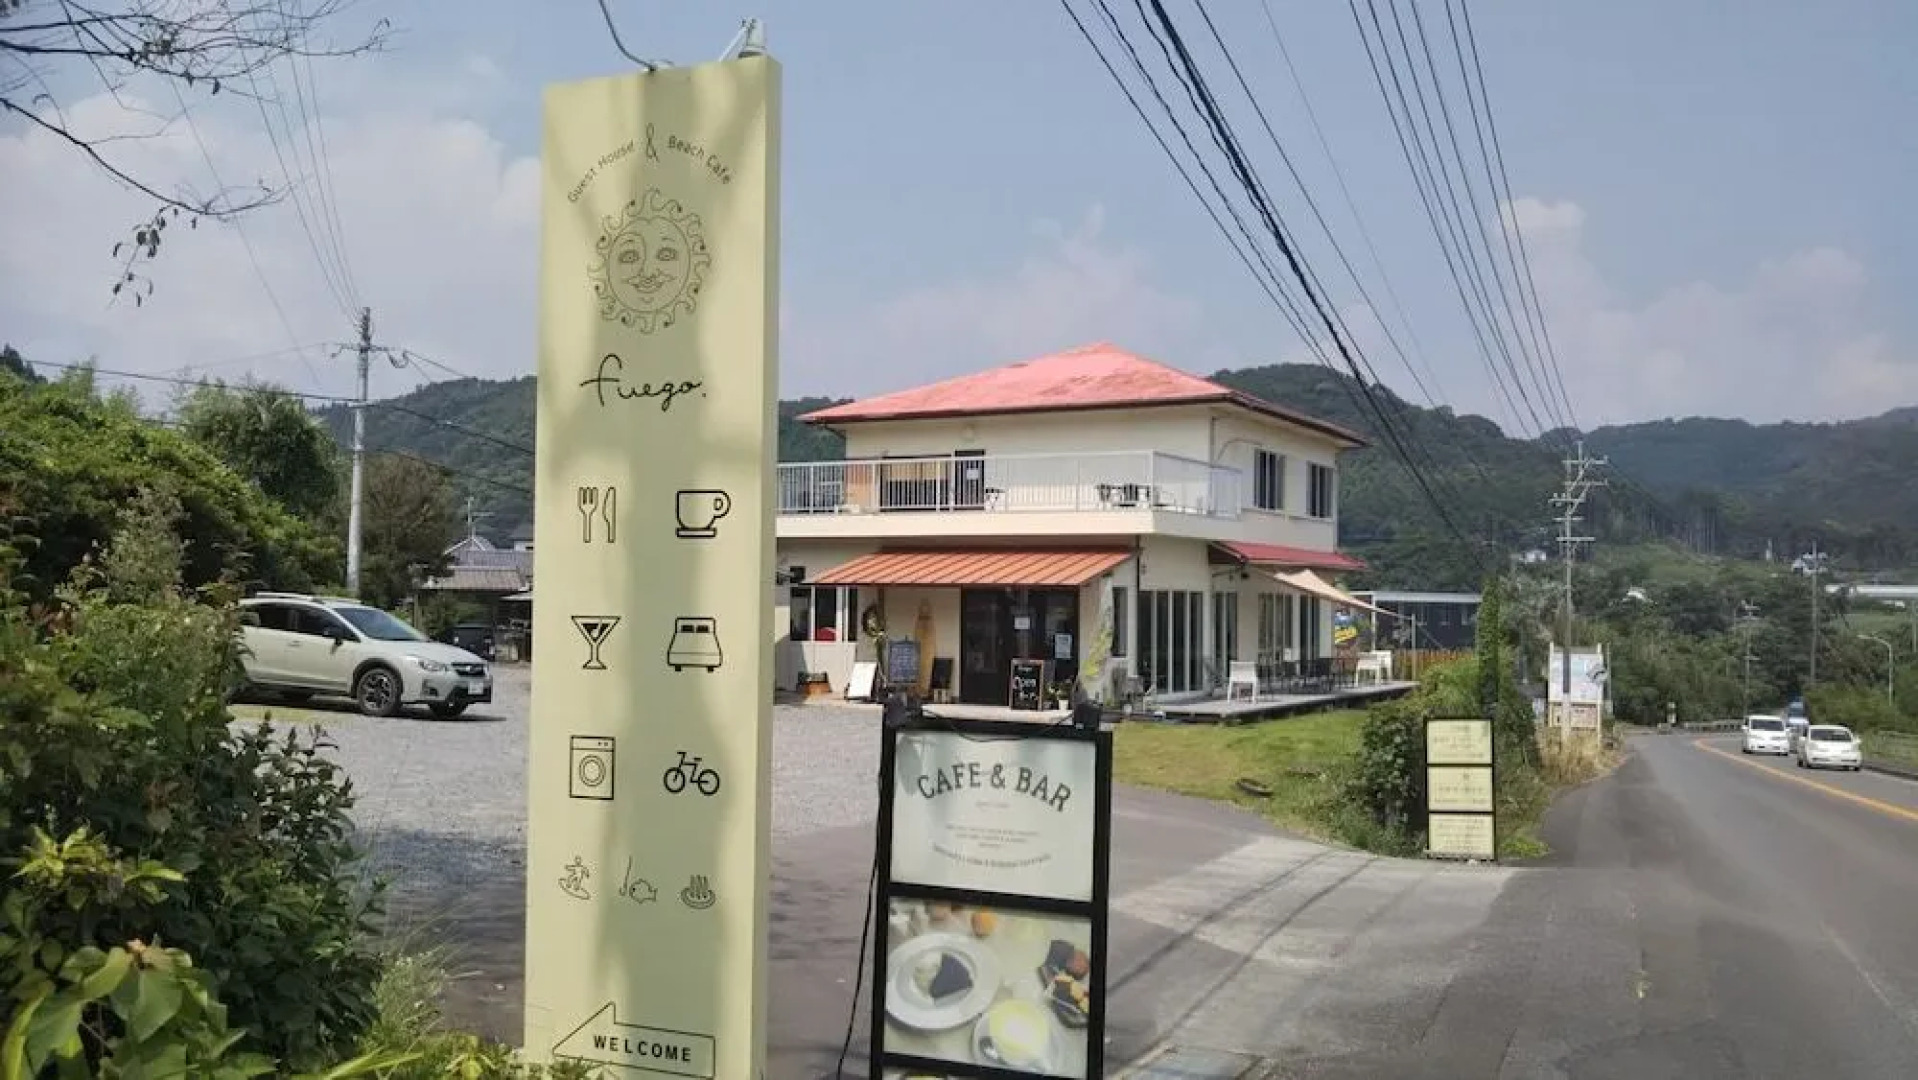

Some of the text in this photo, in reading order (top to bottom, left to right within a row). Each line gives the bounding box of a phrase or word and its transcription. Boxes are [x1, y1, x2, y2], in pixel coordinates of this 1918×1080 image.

[567, 122, 732, 203] Guest House & Beach Cafe
[917, 762, 1072, 812] CAFE & BAR
[593, 1034, 692, 1062] WELCOME
